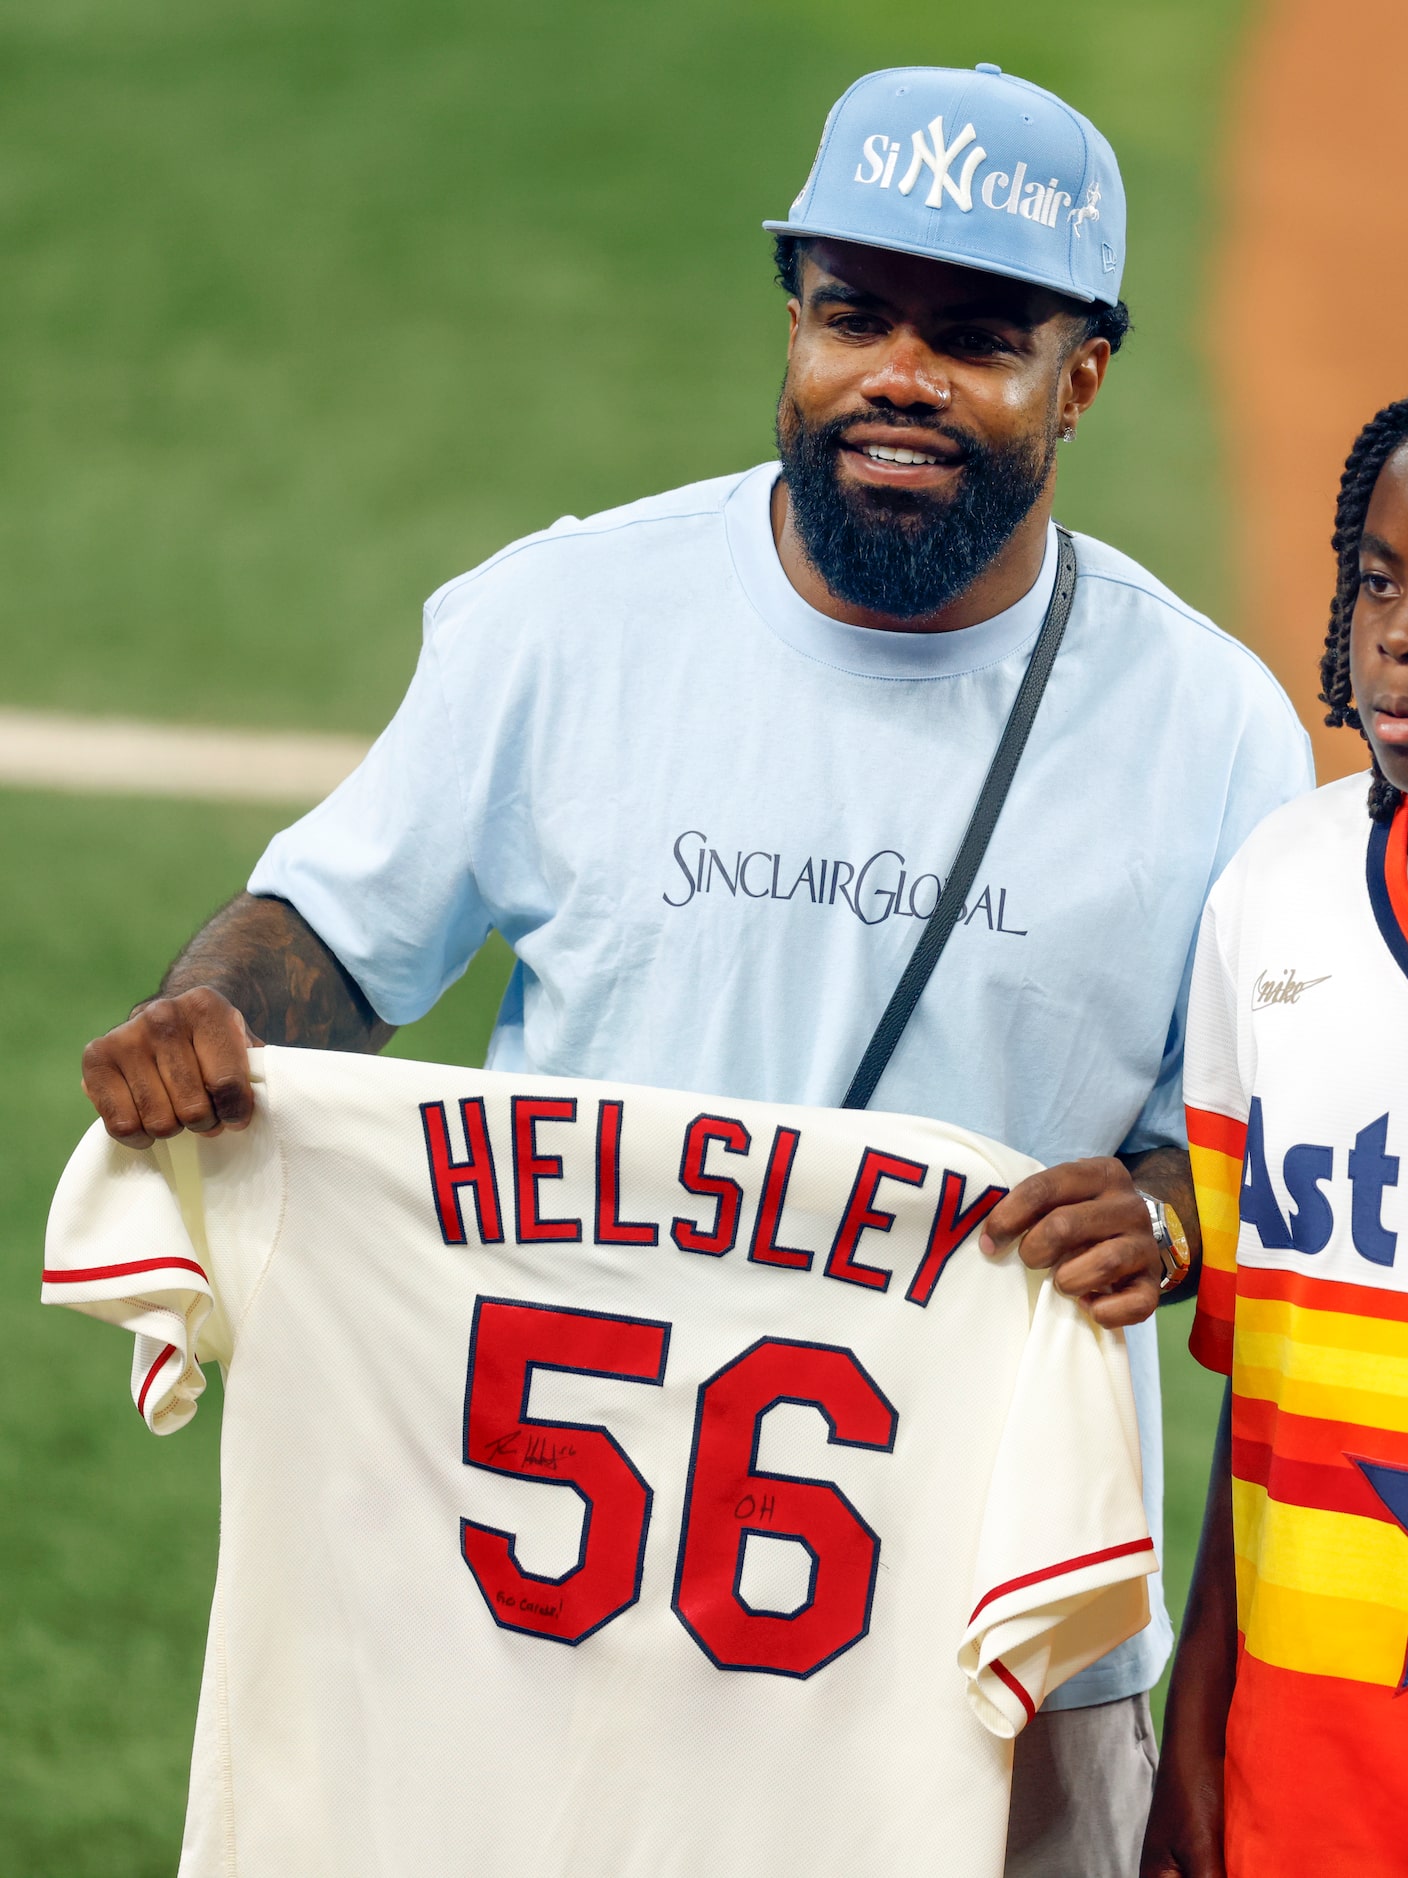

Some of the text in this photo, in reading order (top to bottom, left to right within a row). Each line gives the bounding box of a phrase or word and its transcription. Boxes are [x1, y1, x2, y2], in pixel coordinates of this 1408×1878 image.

[419, 1095, 1010, 1308] HELSLEY
[460, 1294, 899, 1680] 56
[734, 1494, 776, 1522] OH
